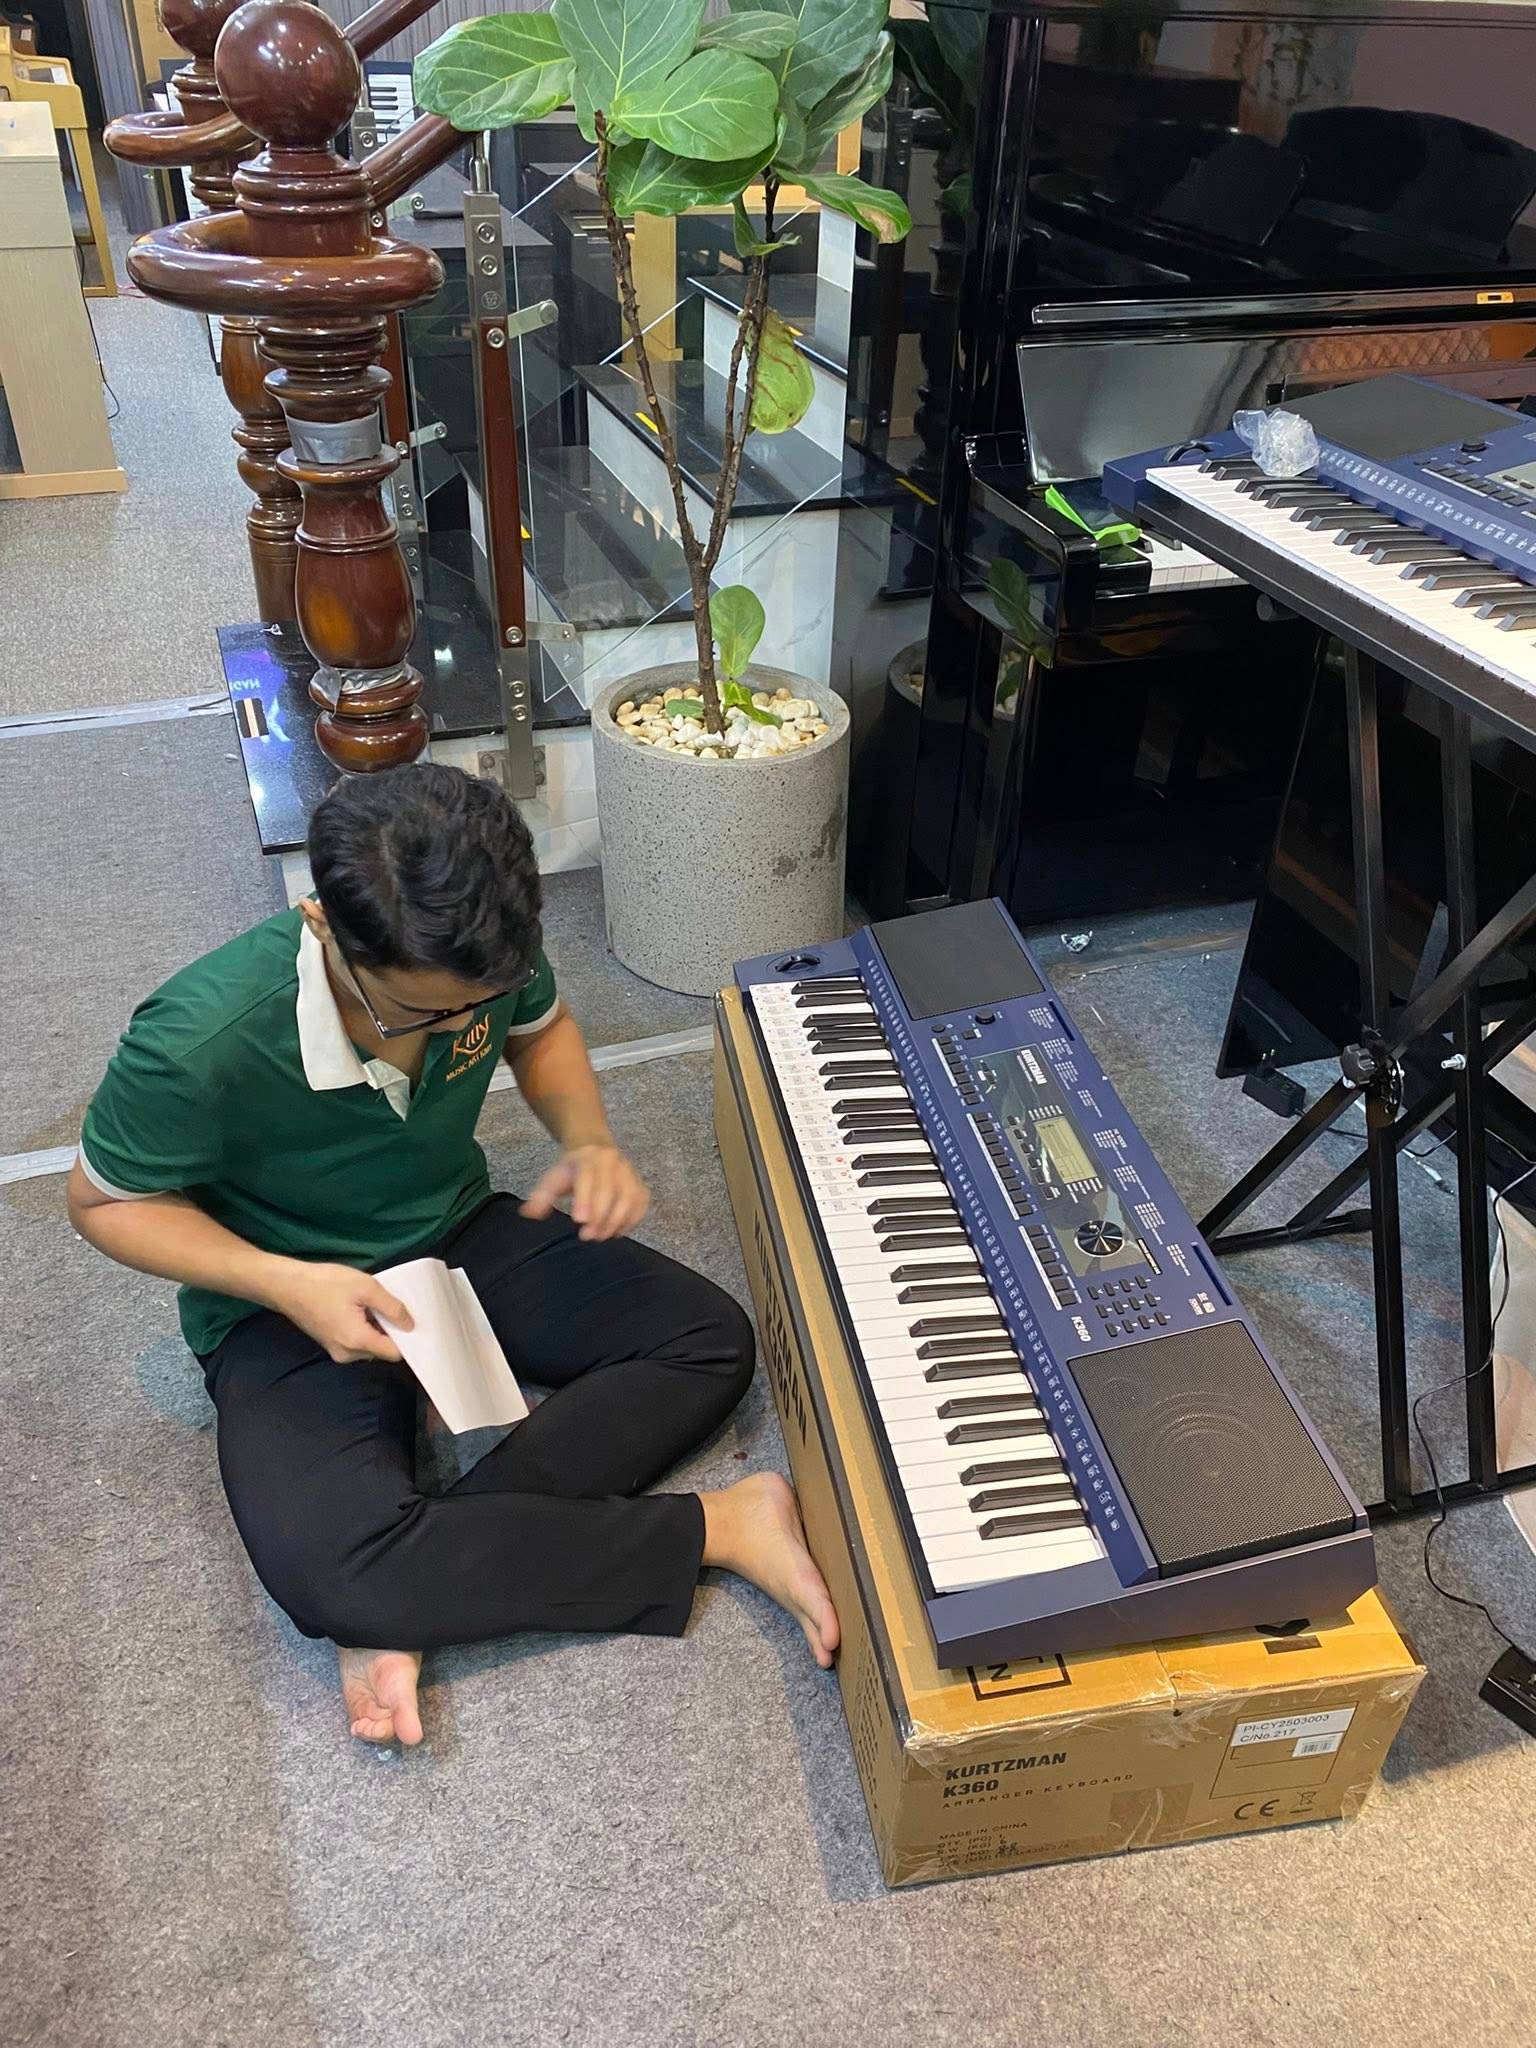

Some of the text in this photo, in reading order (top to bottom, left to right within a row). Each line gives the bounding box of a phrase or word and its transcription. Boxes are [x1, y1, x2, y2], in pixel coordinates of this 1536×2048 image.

[1071, 1316, 1092, 1342] K360
[1243, 1714, 1330, 1732] PI-CY2503003
[945, 1752, 1067, 1781] KURTZMAN
[943, 1779, 999, 1798] K360
[943, 1774, 1134, 1808] ARRANGER KEYBOARD
[939, 1822, 1029, 1840] MADE IN CHINA
